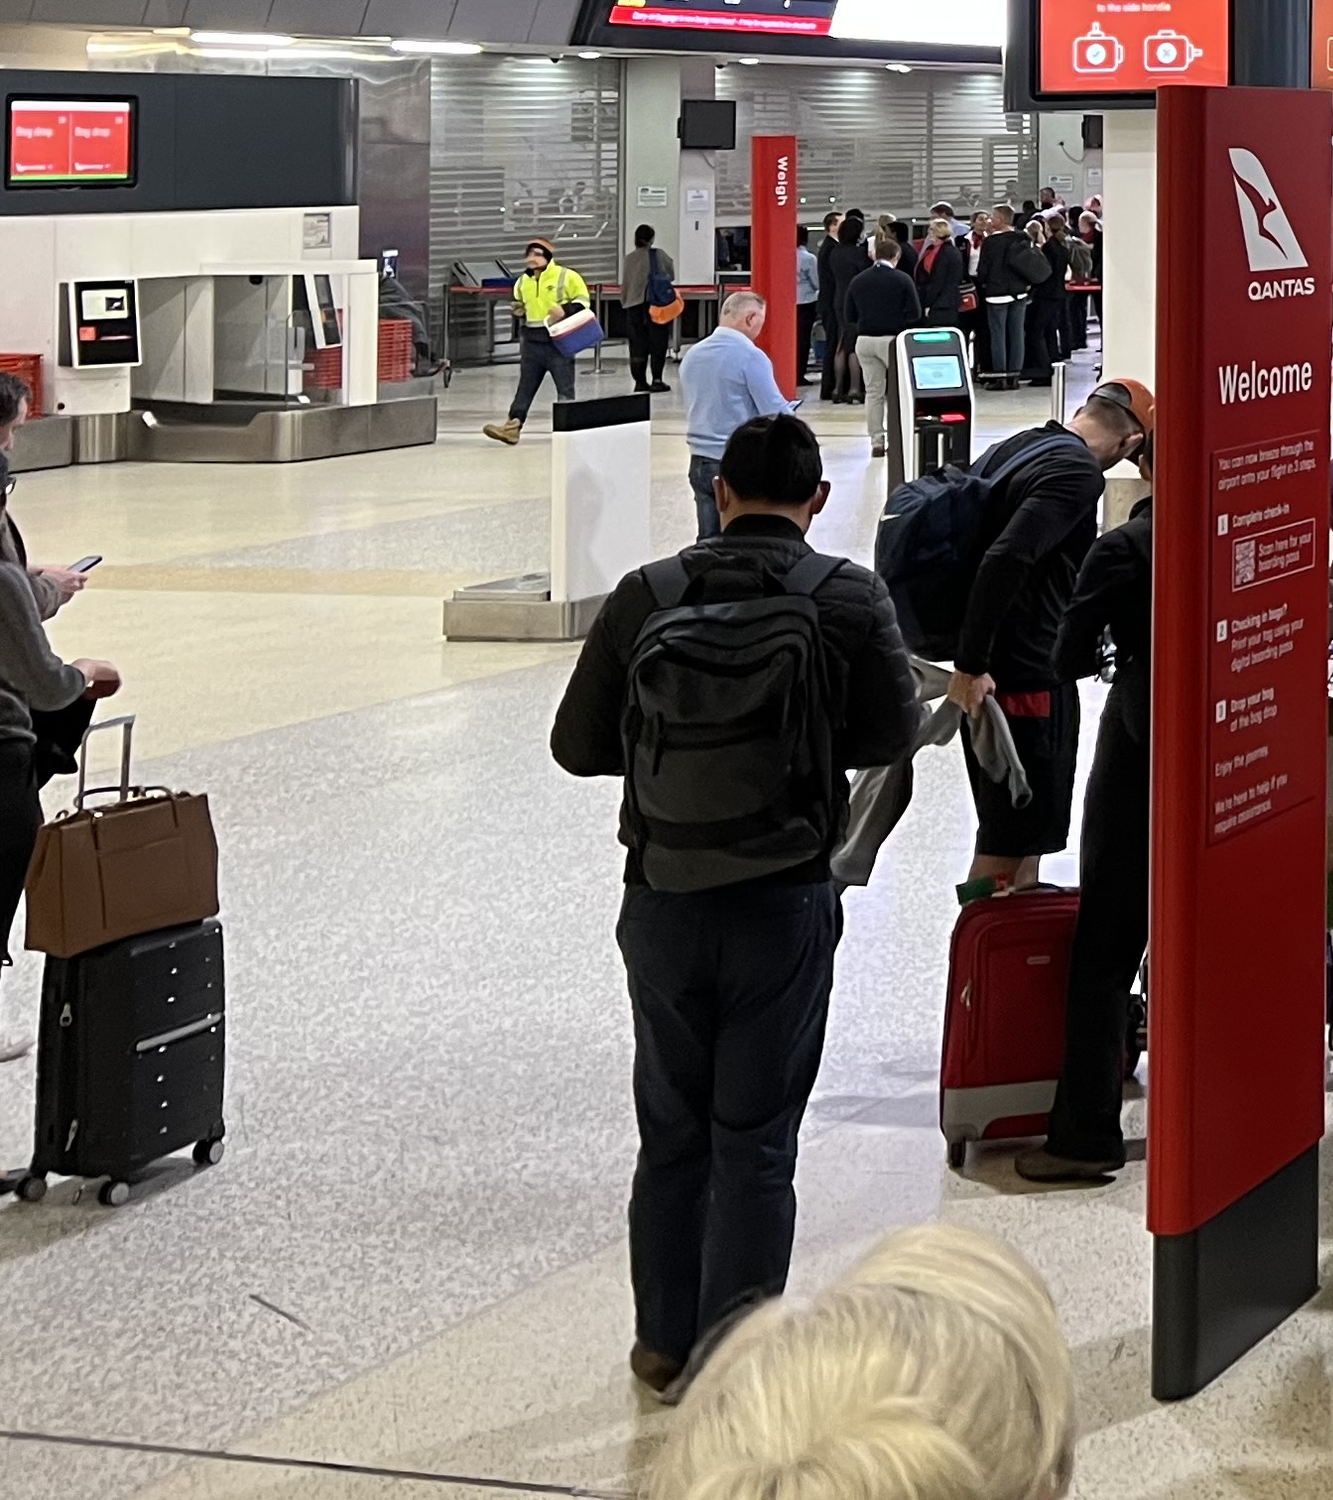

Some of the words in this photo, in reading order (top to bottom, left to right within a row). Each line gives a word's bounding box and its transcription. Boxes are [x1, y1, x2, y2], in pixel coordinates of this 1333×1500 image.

[775, 156, 788, 206] Weigh
[1248, 277, 1315, 301] QANTAS
[1218, 360, 1313, 405] Welcome
[1232, 510, 1262, 528] Complete
[1219, 623, 1224, 638] 2
